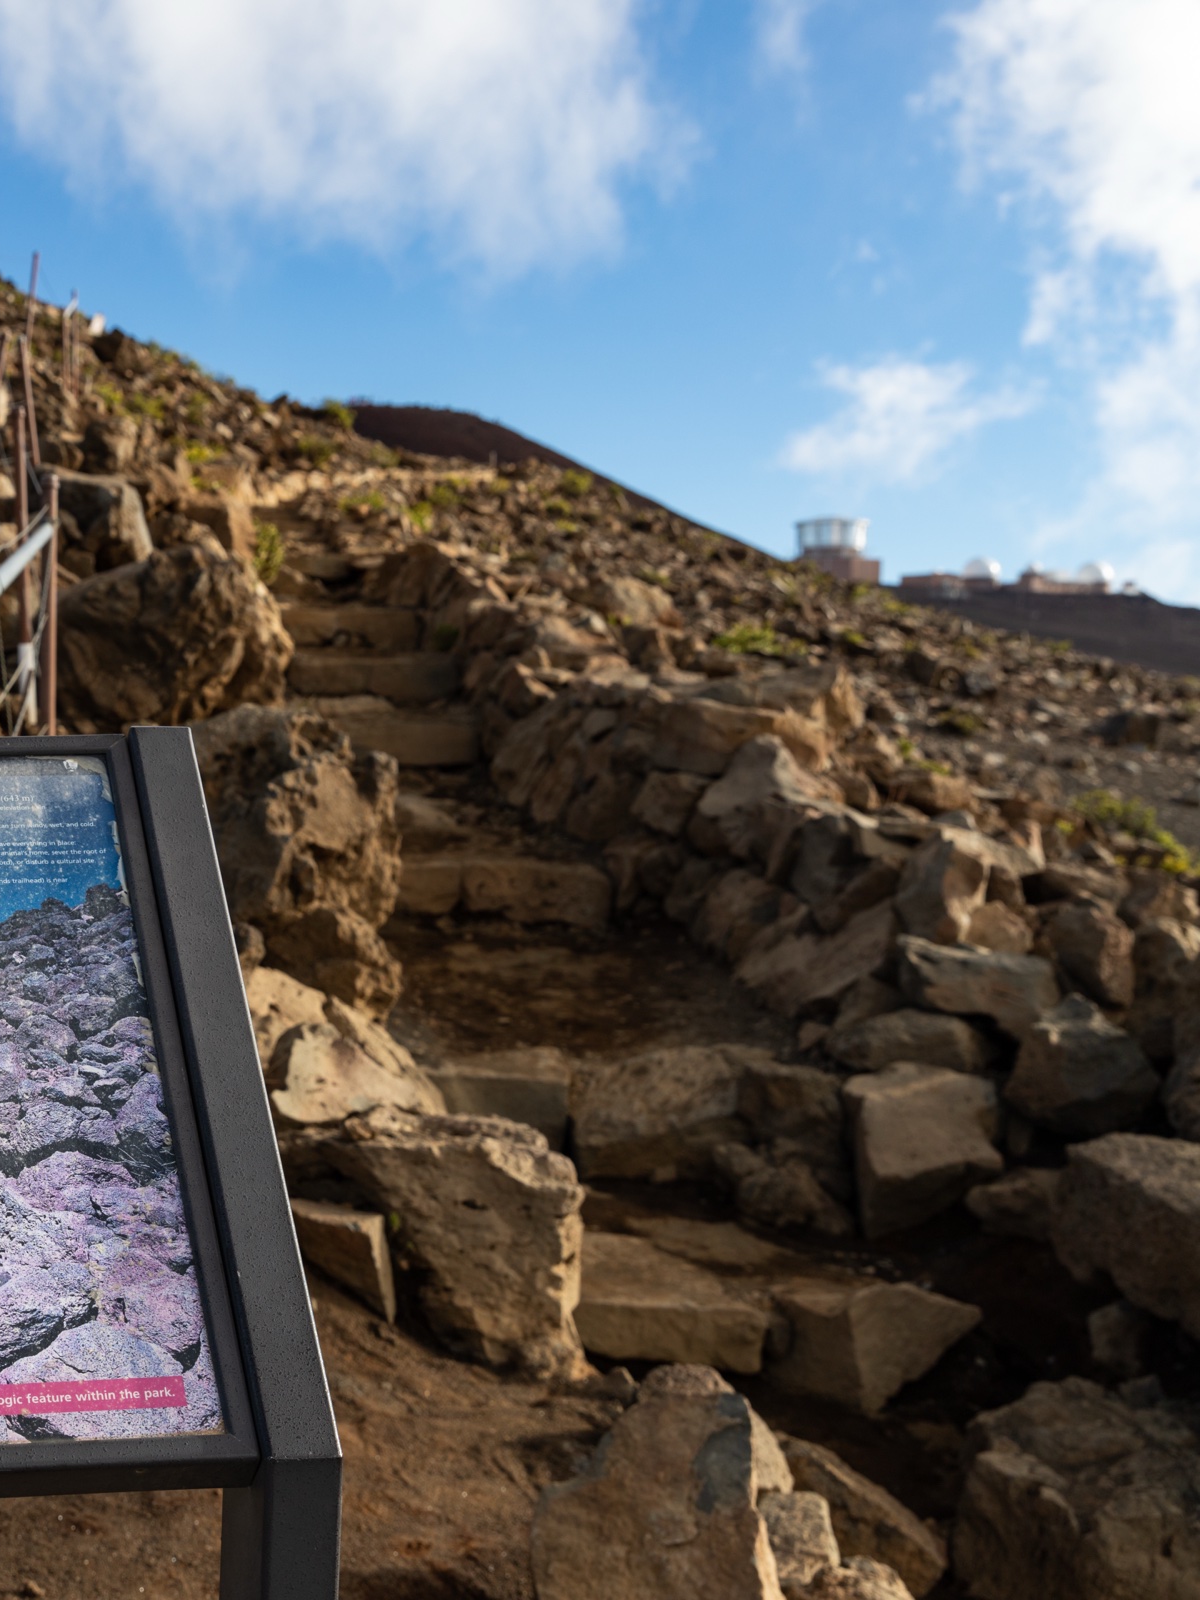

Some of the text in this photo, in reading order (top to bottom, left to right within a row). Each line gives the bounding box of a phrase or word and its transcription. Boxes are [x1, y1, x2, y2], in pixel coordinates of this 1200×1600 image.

[0, 795, 19, 803] (643
[26, 1391, 71, 1404] feature
[75, 1389, 116, 1402] within
[120, 1388, 140, 1400] the
[144, 1386, 175, 1401] park.
